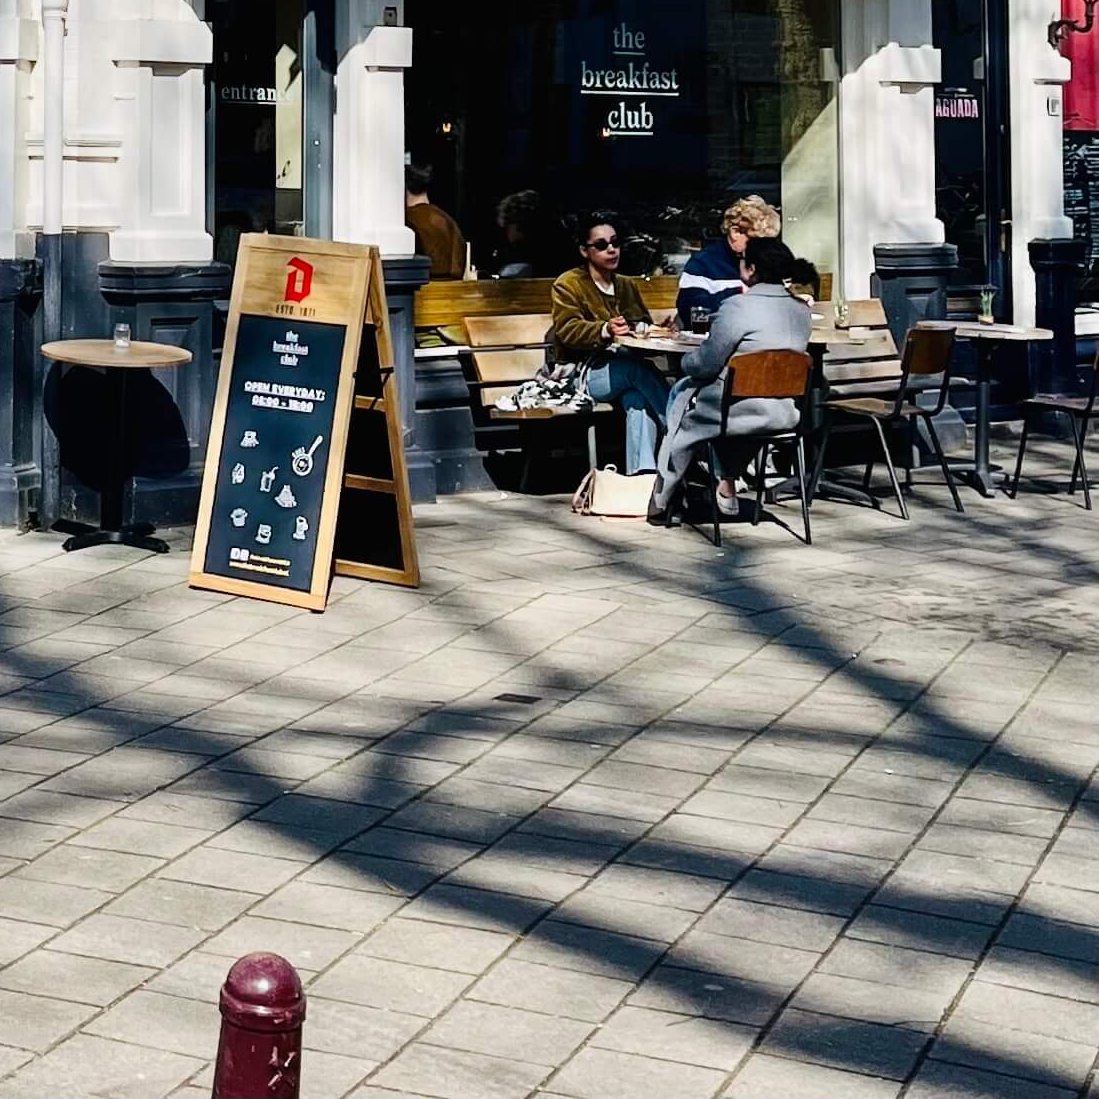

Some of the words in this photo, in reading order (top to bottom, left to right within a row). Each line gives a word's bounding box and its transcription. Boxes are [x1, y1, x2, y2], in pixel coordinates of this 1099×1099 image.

[612, 22, 646, 49] the
[581, 60, 680, 90] breakfast
[221, 84, 294, 101] entran
[607, 101, 654, 129] club
[935, 97, 979, 118] AGUADA
[244, 380, 273, 394] OPEN
